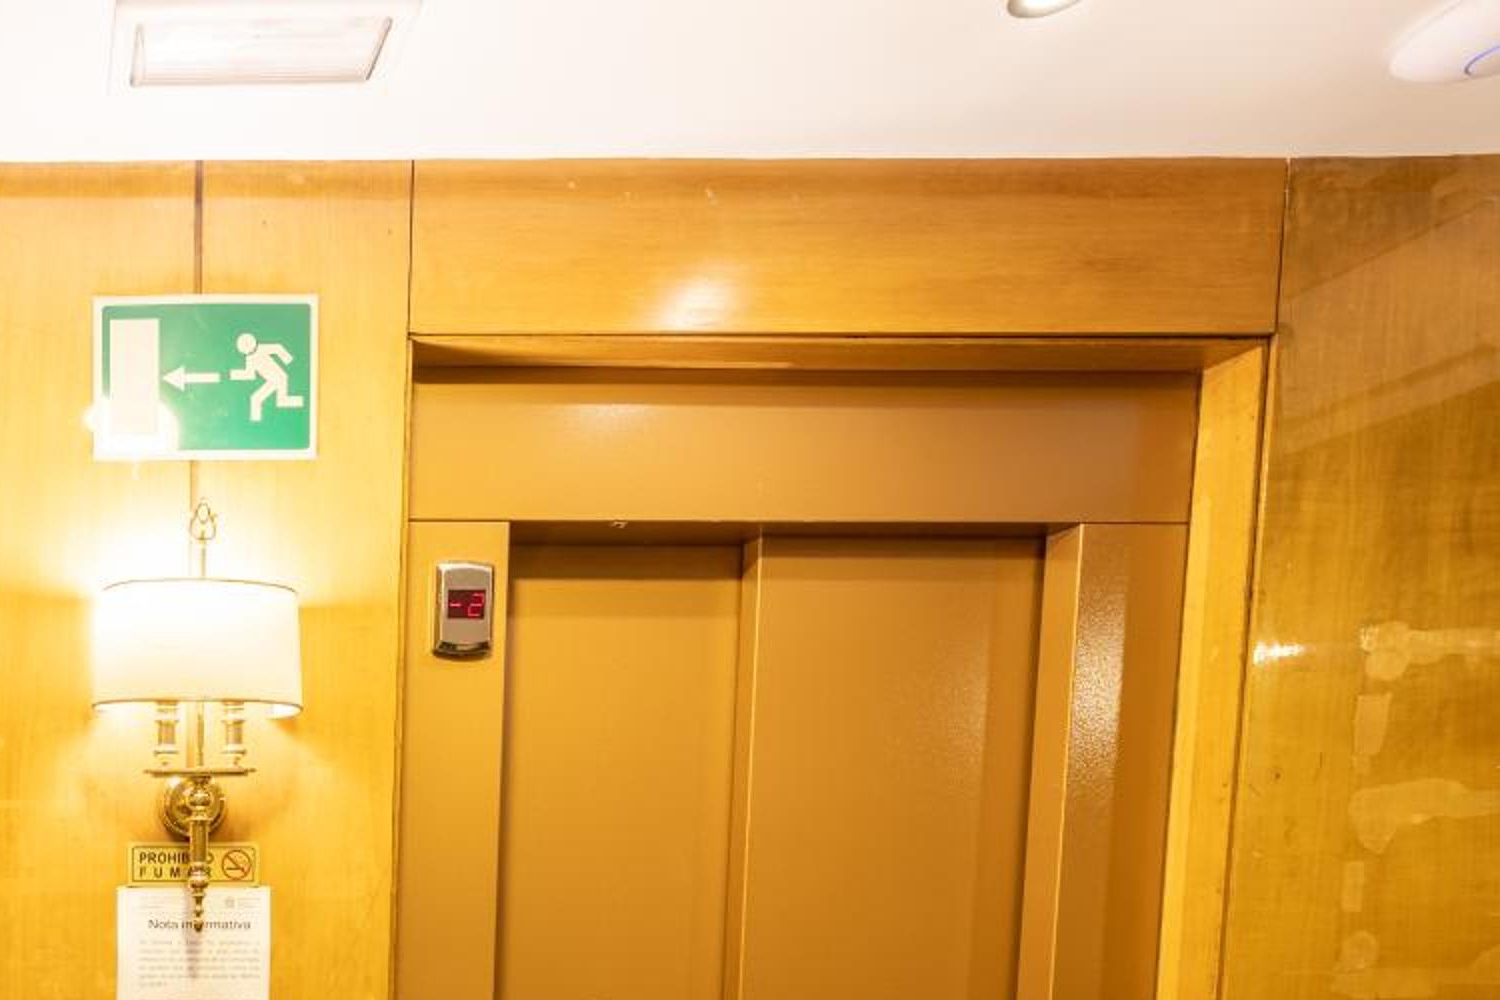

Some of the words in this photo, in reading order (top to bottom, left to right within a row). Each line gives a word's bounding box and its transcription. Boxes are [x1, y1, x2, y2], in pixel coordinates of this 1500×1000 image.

[449, 592, 485, 617] -2
[139, 851, 214, 865] PROHIBO
[148, 919, 179, 929] Nota
[181, 919, 251, 930] inrmativa
